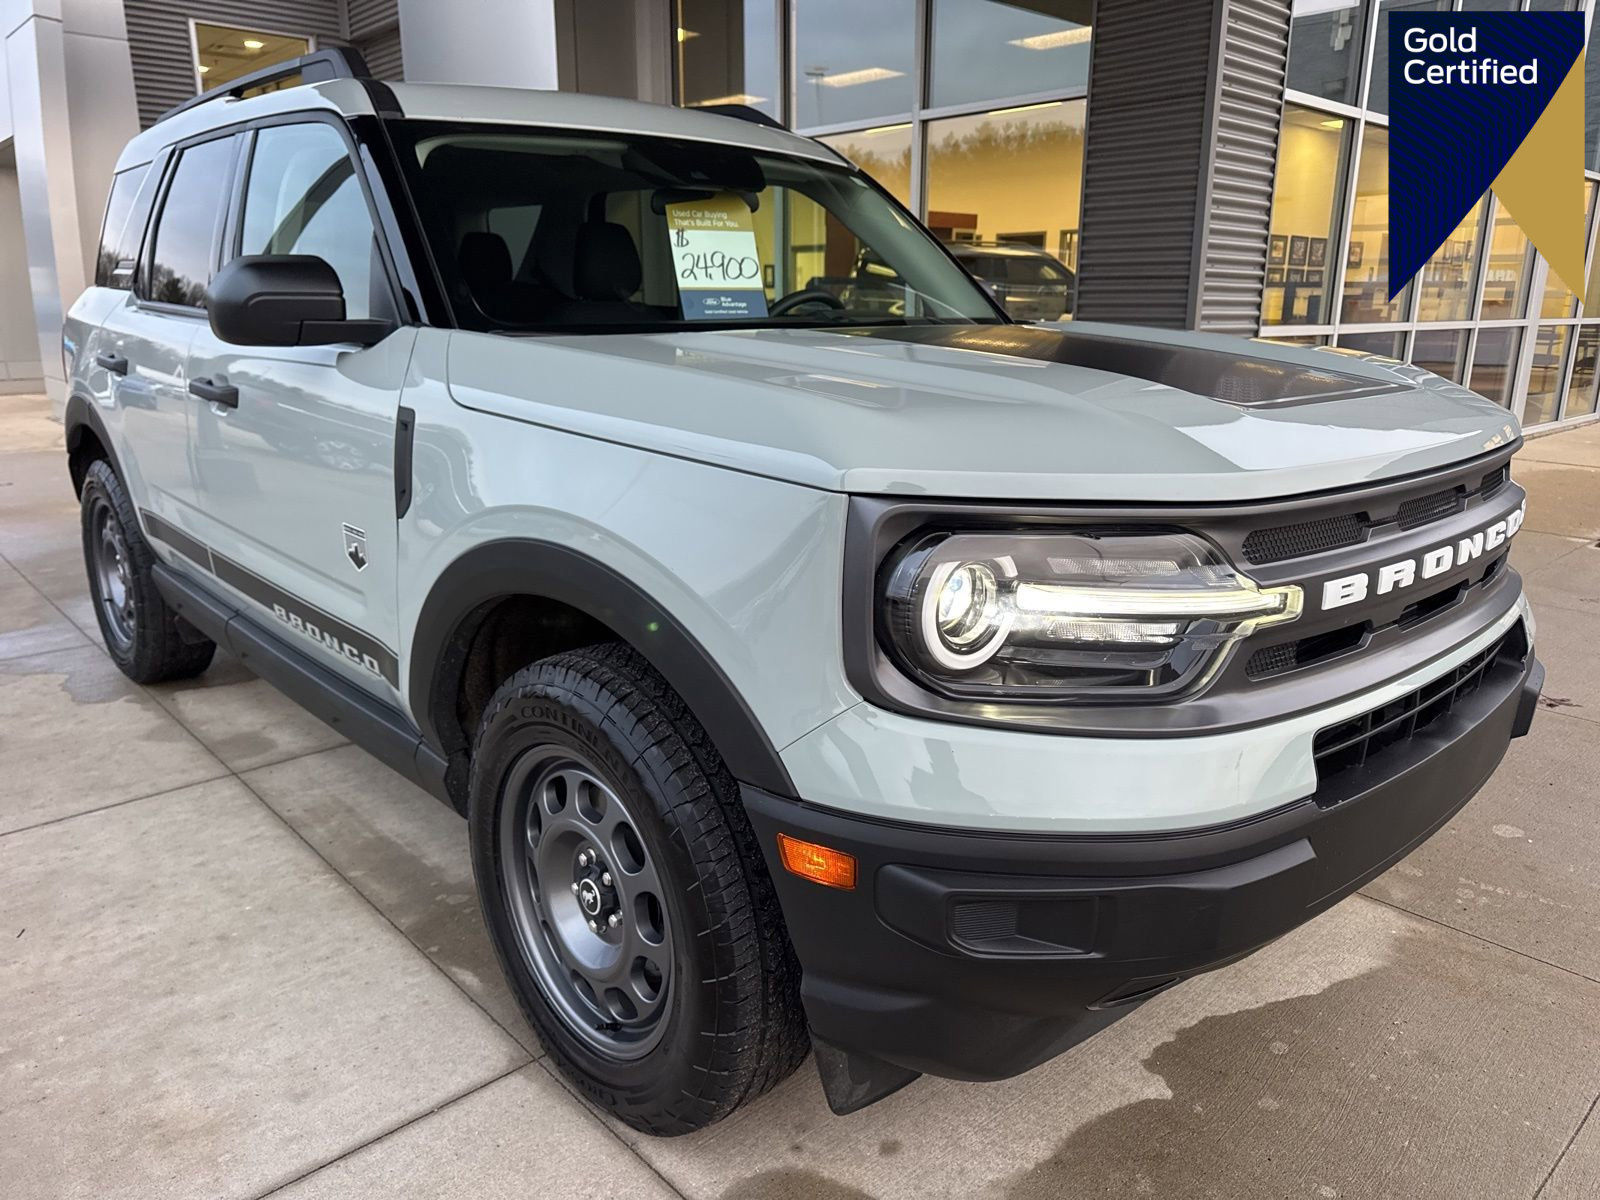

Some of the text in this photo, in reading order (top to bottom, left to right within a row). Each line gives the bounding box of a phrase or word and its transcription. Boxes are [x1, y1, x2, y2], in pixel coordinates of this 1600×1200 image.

[672, 209, 690, 217] Used
[704, 210, 728, 220] Buying
[674, 218, 694, 227] That's
[712, 219, 724, 227] For
[1321, 508, 1522, 611] BRONCO
[273, 602, 382, 677] BRONCO
